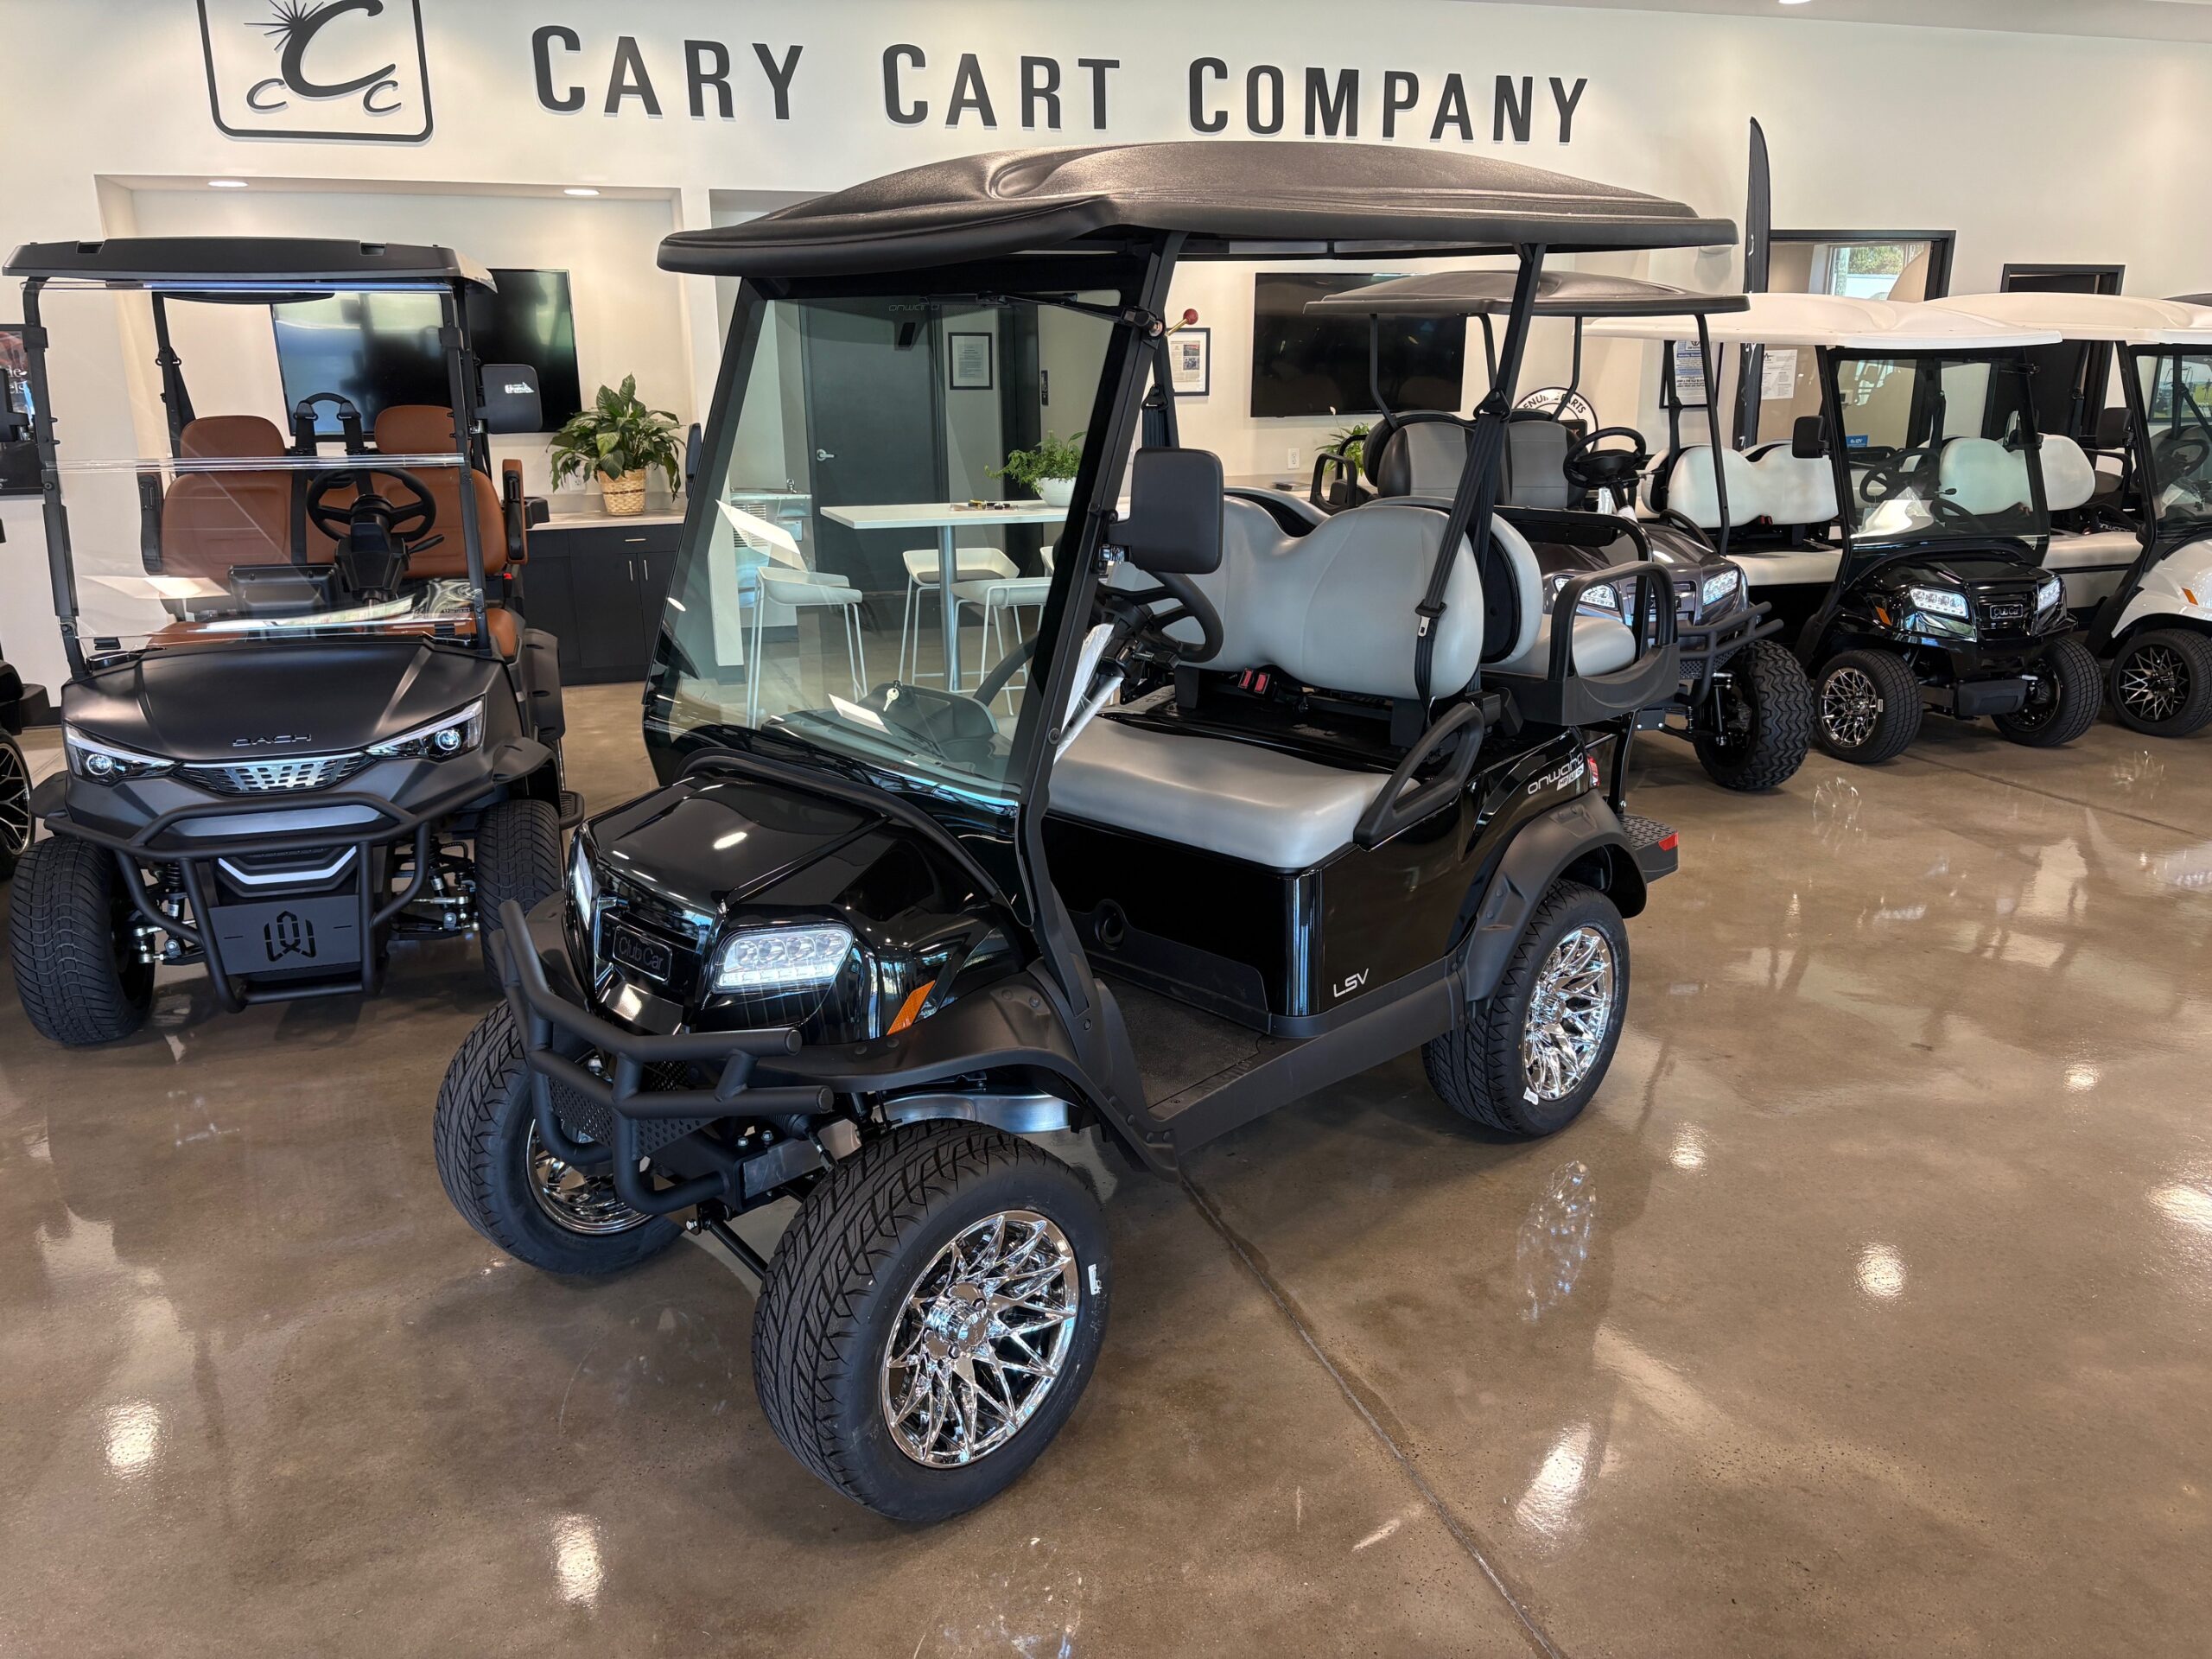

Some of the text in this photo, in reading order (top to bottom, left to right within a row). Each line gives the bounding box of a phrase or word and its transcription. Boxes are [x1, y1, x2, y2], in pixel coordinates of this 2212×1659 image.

[531, 25, 1588, 143] CARY CART COMPANY
[619, 936, 664, 970] Club Car
[1333, 968, 1369, 997] LSV
